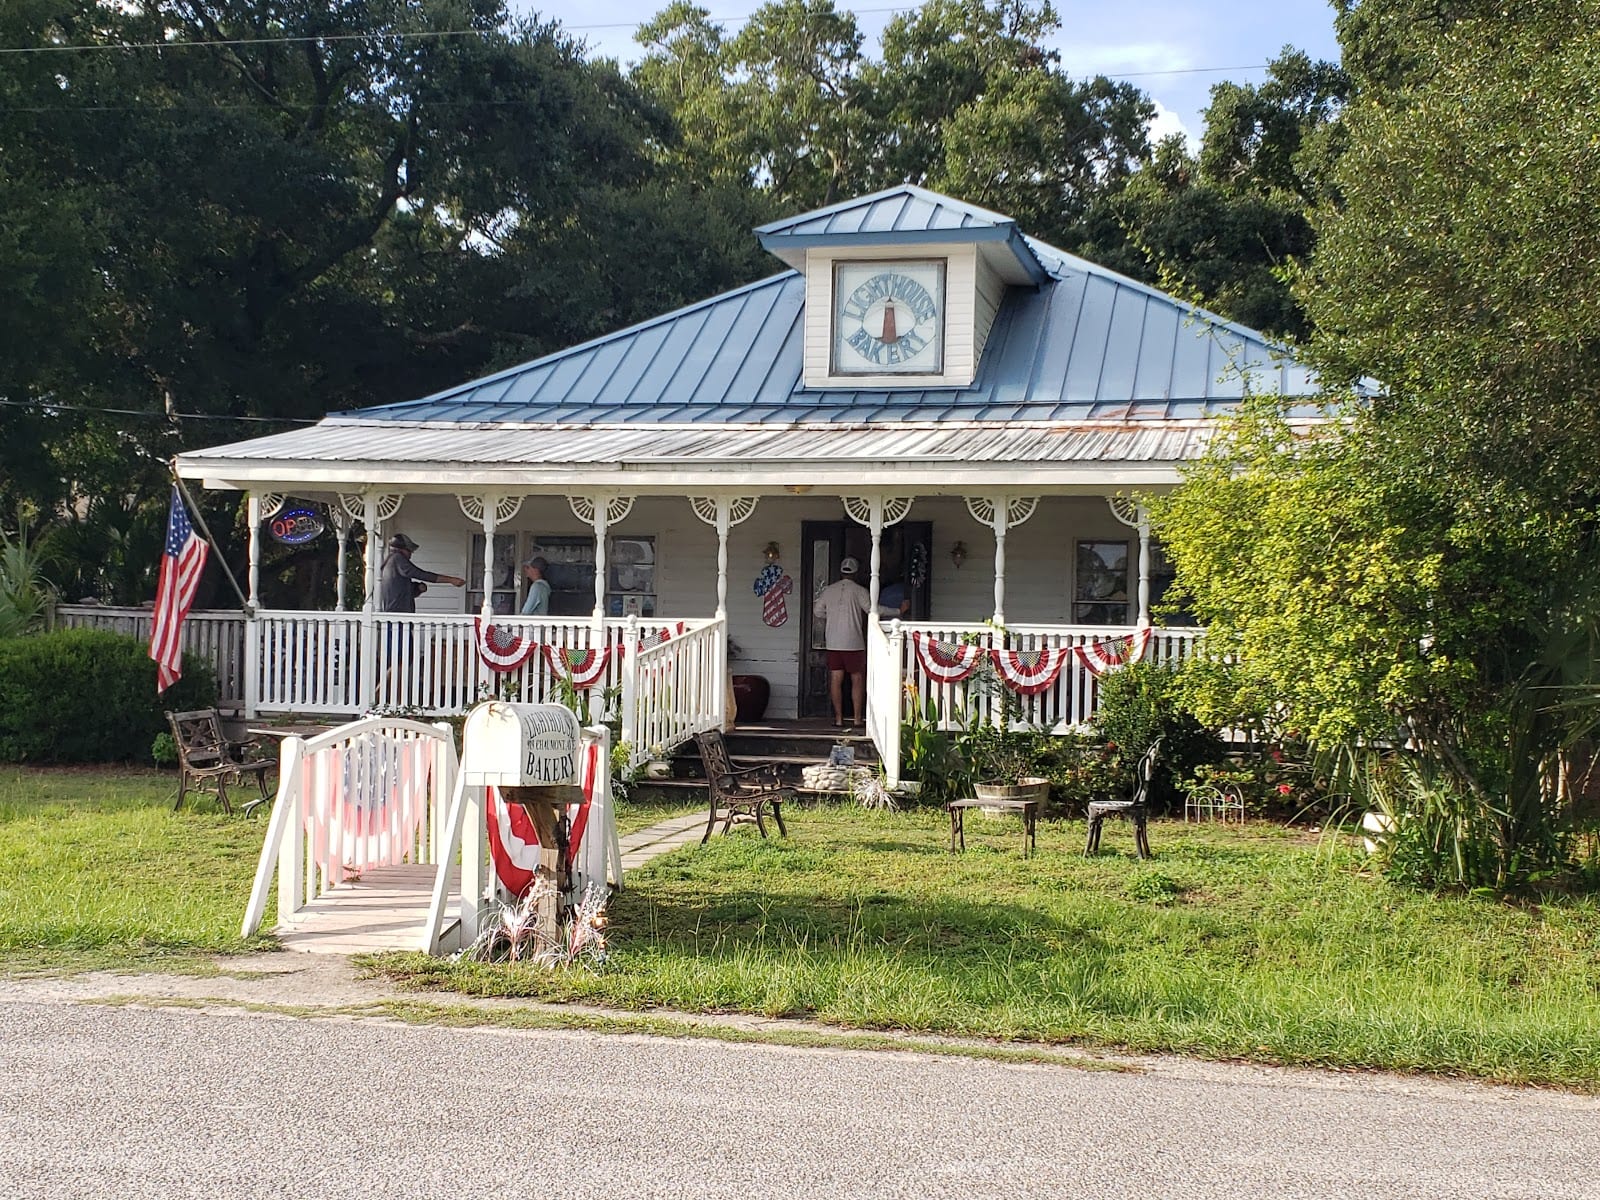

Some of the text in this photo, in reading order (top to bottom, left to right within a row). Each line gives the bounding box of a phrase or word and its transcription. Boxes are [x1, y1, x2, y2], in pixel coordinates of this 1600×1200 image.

[842, 272, 936, 326] LIGHTHOUSE
[848, 327, 926, 365] BAKERY
[525, 711, 575, 740] LIGHTHOUSE
[526, 751, 575, 782] BAKERY
